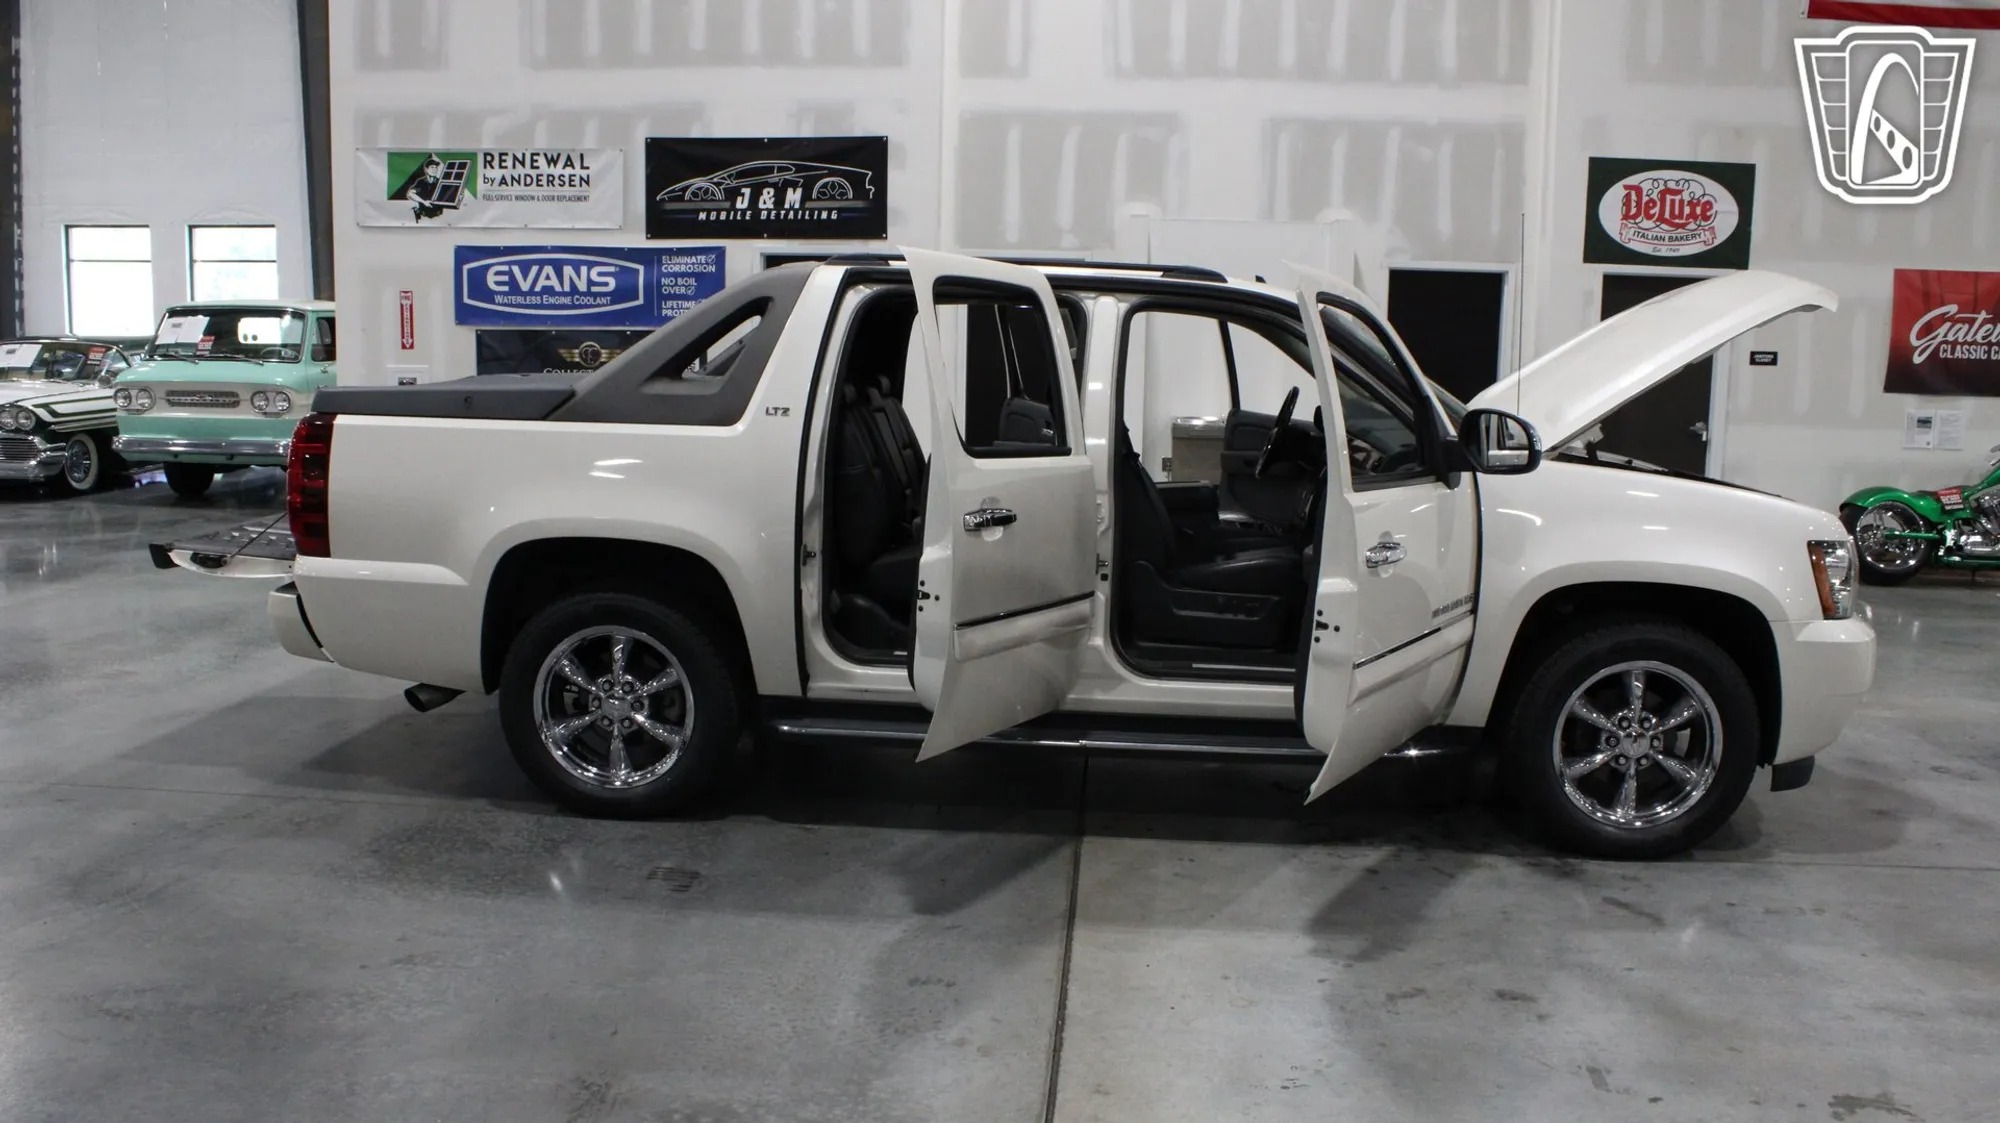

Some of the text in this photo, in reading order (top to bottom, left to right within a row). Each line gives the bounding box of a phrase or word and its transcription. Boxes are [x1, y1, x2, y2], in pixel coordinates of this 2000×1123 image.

[483, 152, 590, 170] RENEWAL
[483, 173, 591, 187] by ANDERSEN
[556, 195, 590, 203] REPLACEMENT
[735, 187, 803, 210] J & M
[1620, 184, 1714, 230] DeLuxe
[698, 210, 838, 221] MOBILE DETAILING
[1632, 230, 1702, 243] ITALIAN BAKERY
[662, 255, 707, 264] ELIMINATE
[662, 264, 716, 273] CORROSION
[486, 265, 617, 292] EVANS
[661, 277, 698, 286] NO BOIL
[662, 286, 687, 295] OVER
[662, 309, 688, 317] PROT
[1939, 344, 2000, 360] CLASSIC C
[765, 406, 791, 416] LTZ
